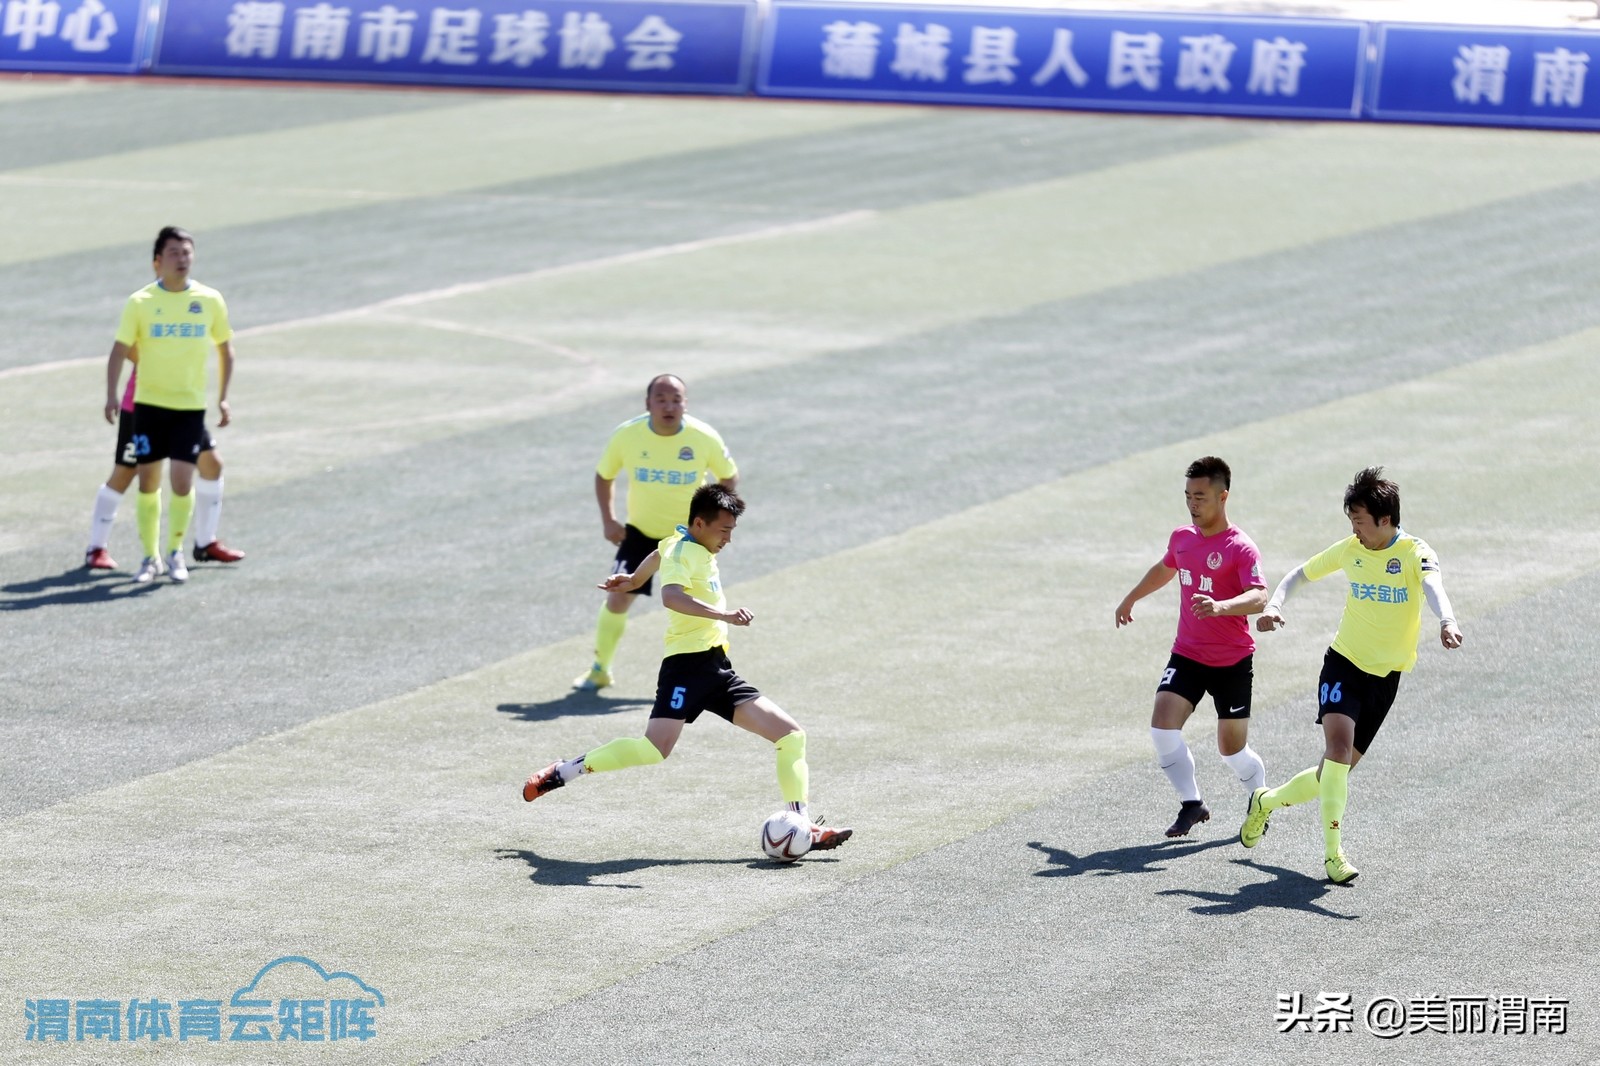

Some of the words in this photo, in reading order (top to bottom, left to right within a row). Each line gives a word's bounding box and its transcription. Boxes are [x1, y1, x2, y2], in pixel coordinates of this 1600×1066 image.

[0, 0, 118, 52] 中心
[225, 1, 683, 71] 渭南市足球协会
[821, 20, 1308, 97] 蒲城县人民政府
[1452, 44, 1591, 107] 渭南
[670, 686, 687, 709] 5
[1320, 681, 1342, 705] 86
